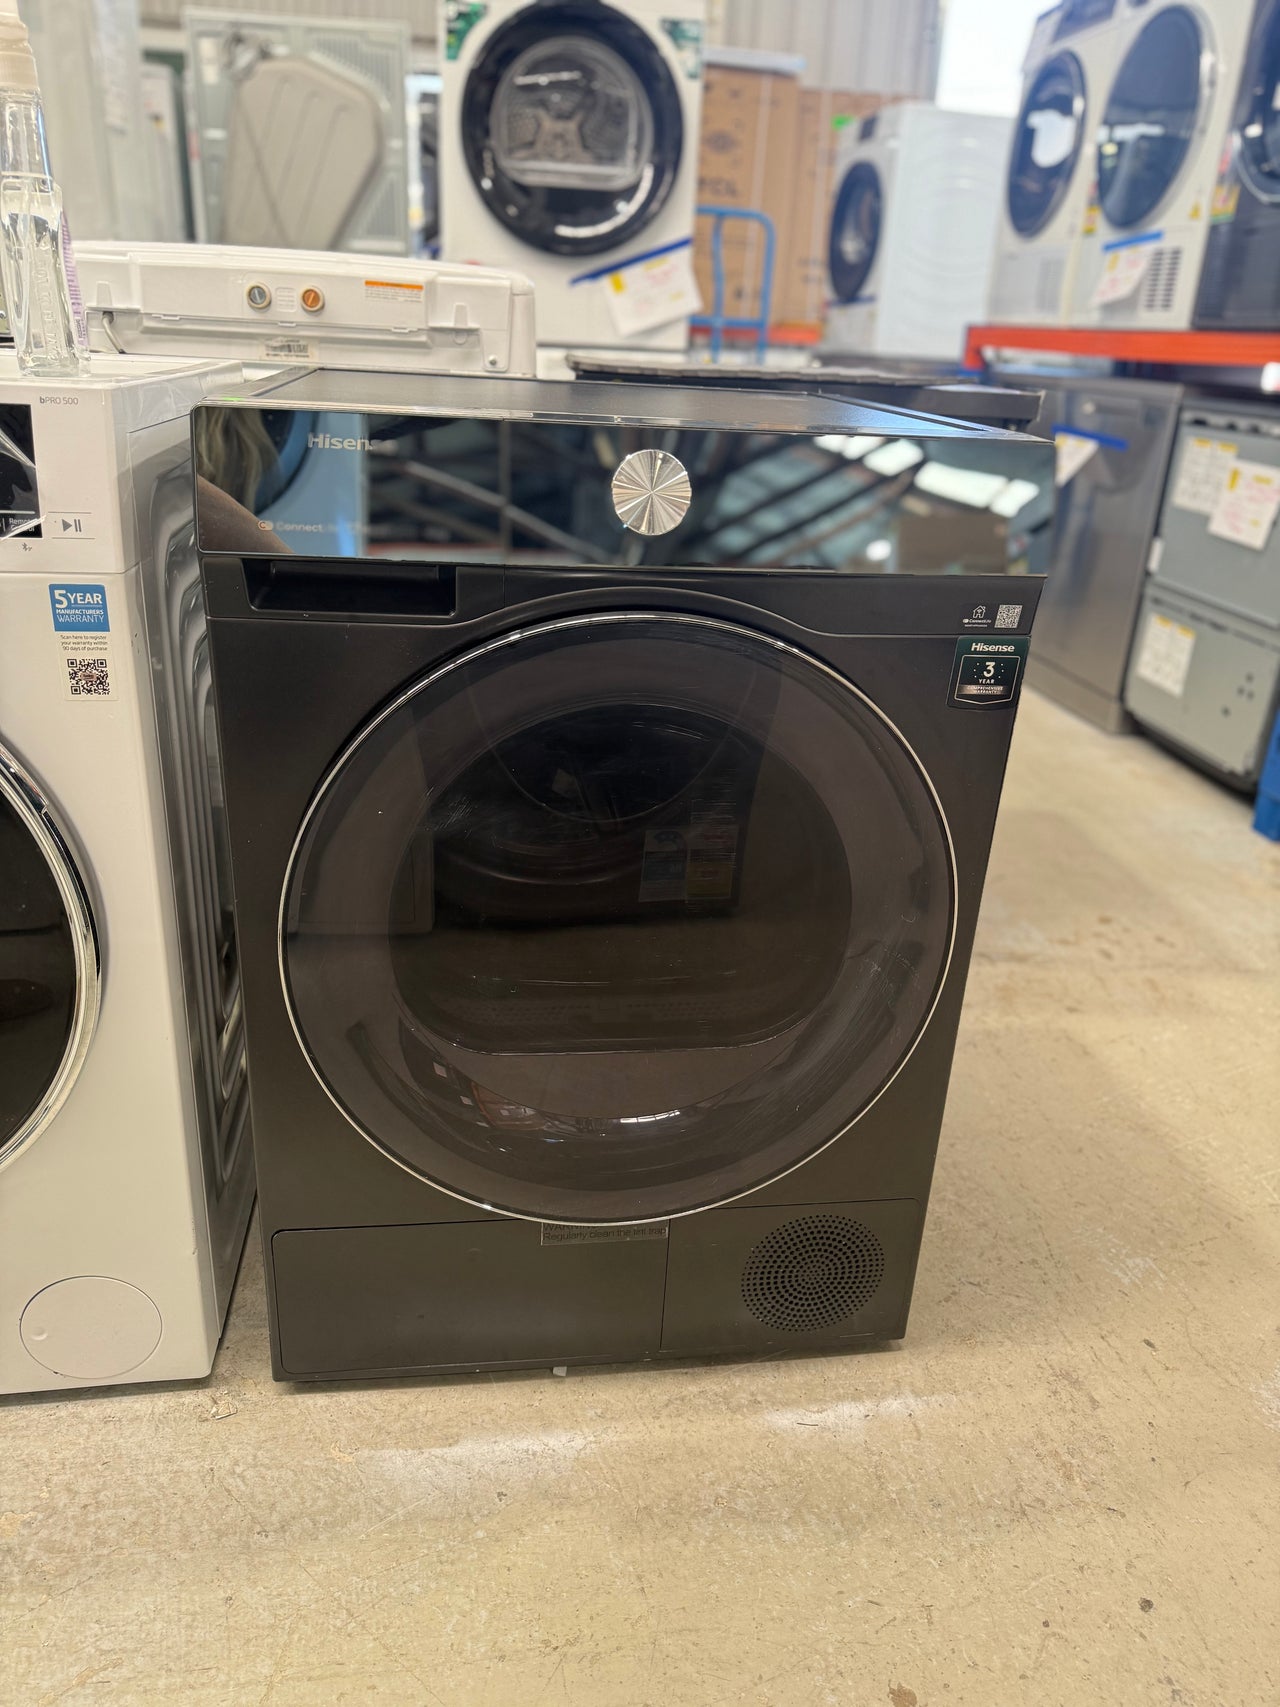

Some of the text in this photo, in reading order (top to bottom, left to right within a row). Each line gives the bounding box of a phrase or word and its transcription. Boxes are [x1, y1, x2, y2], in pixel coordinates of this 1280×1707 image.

[62, 397, 79, 405] 500
[55, 589, 103, 609] 5 YEAR
[57, 614, 105, 623] WARRANTY
[971, 642, 1015, 652] Hisense
[983, 661, 996, 678] 3
[543, 1231, 588, 1242] Regularly
[589, 1229, 614, 1239] clean
[617, 1228, 631, 1237] the
